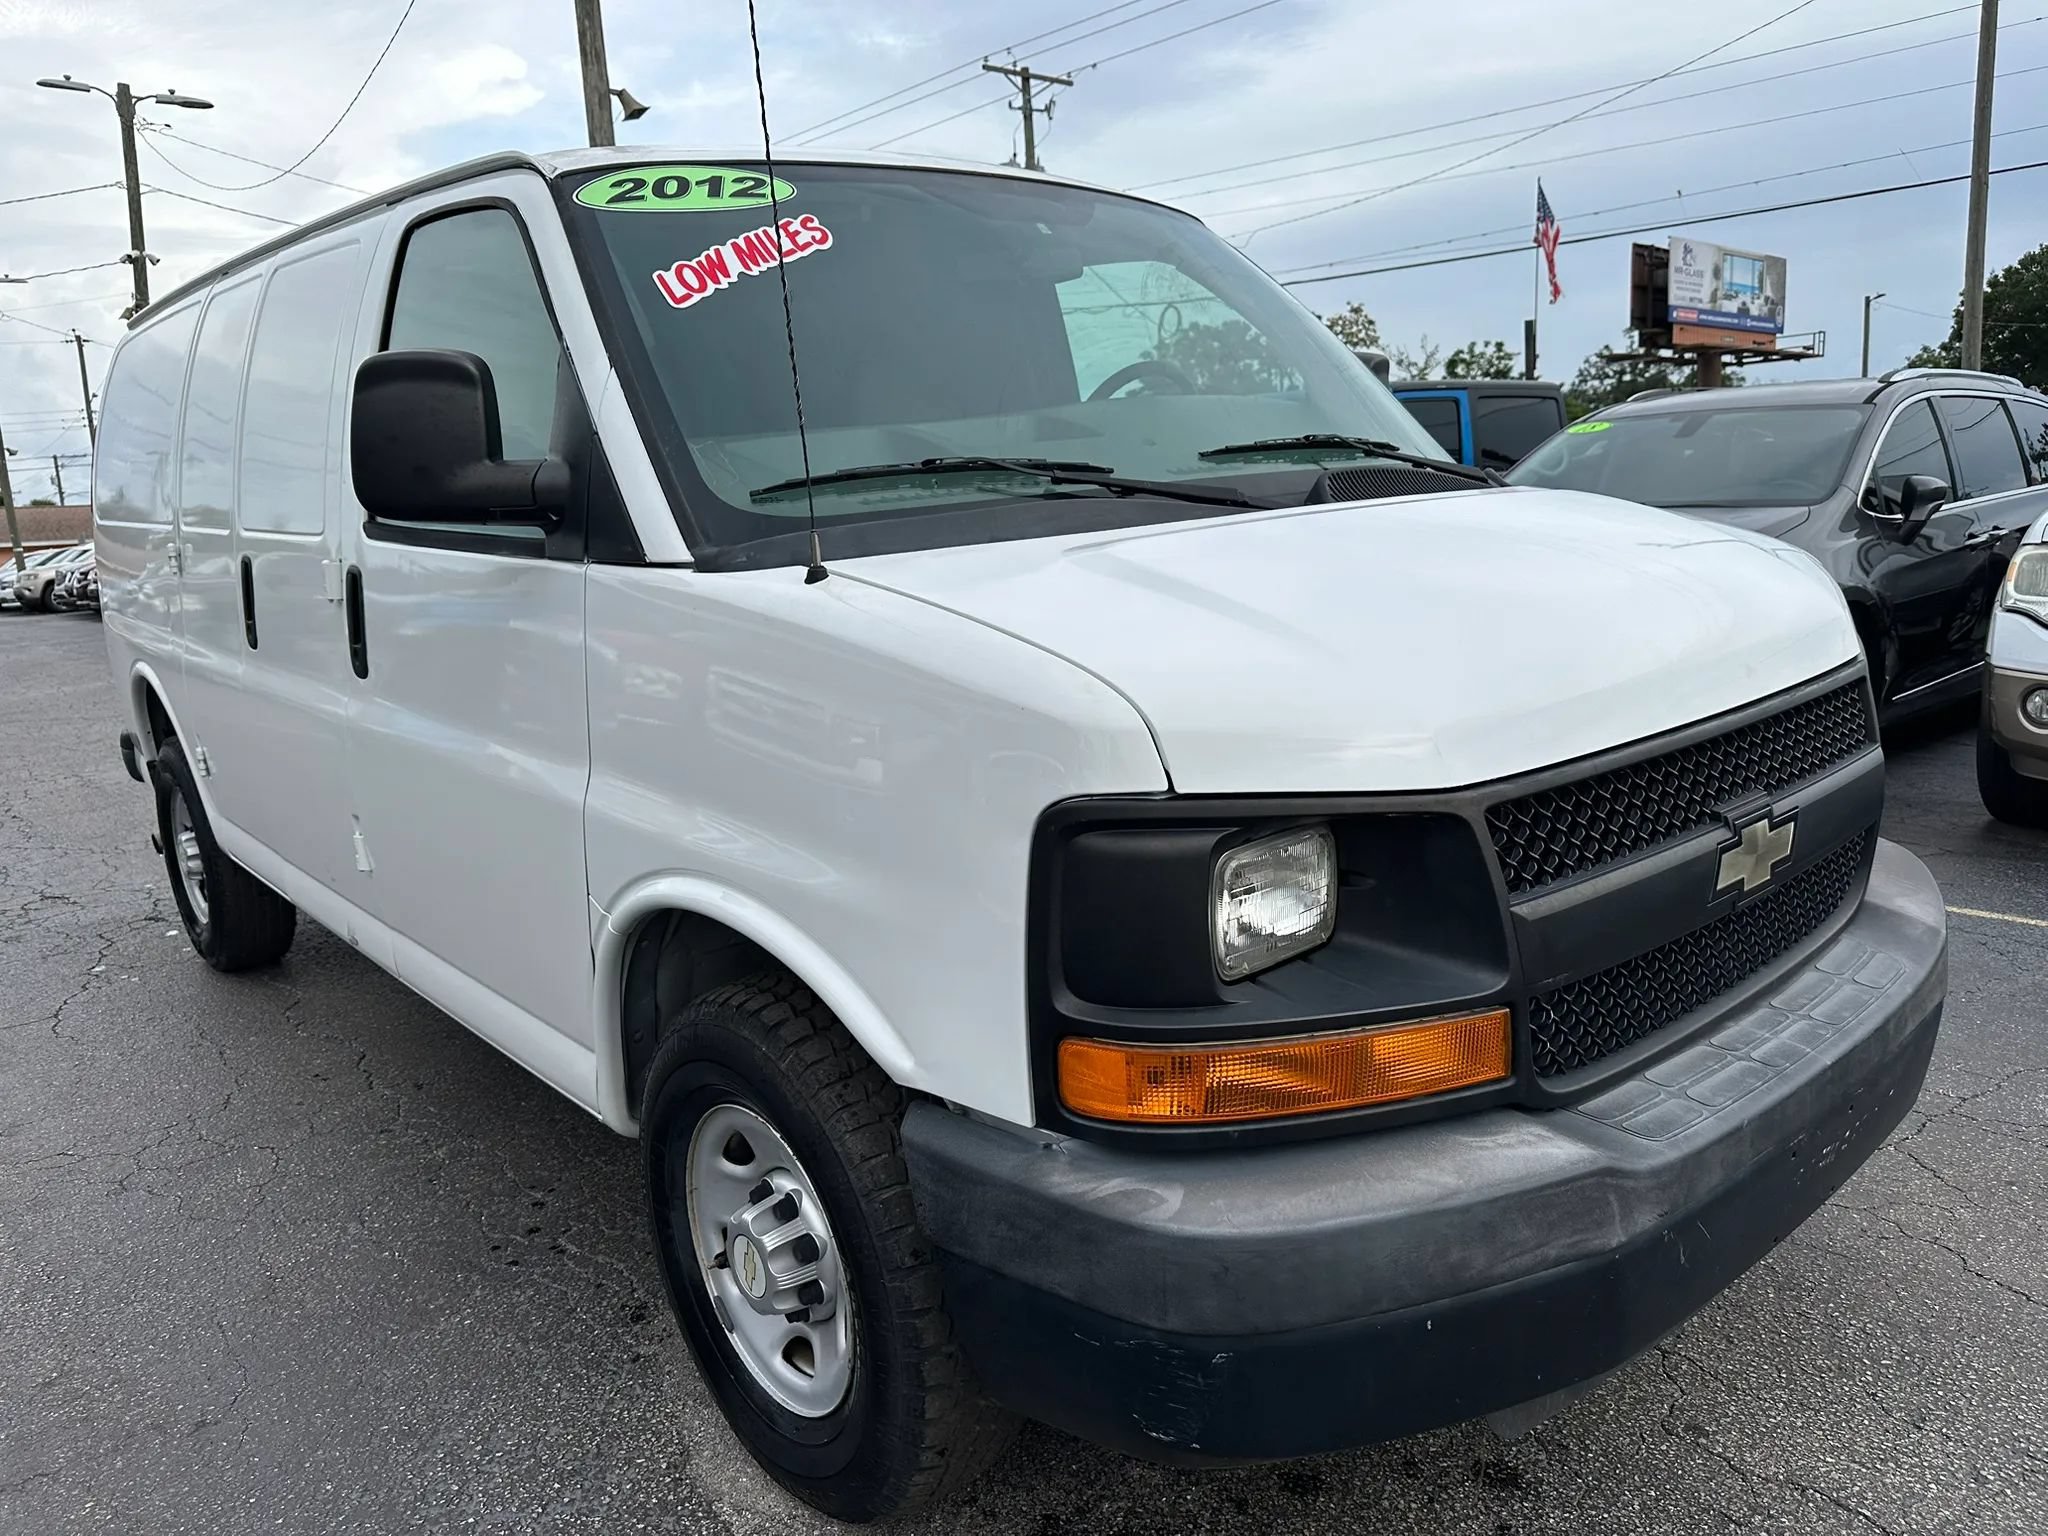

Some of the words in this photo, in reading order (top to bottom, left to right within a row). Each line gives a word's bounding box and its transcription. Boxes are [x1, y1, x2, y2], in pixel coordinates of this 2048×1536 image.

[605, 175, 770, 204] 2012
[656, 248, 731, 305] LOW
[730, 215, 829, 272] MILES
